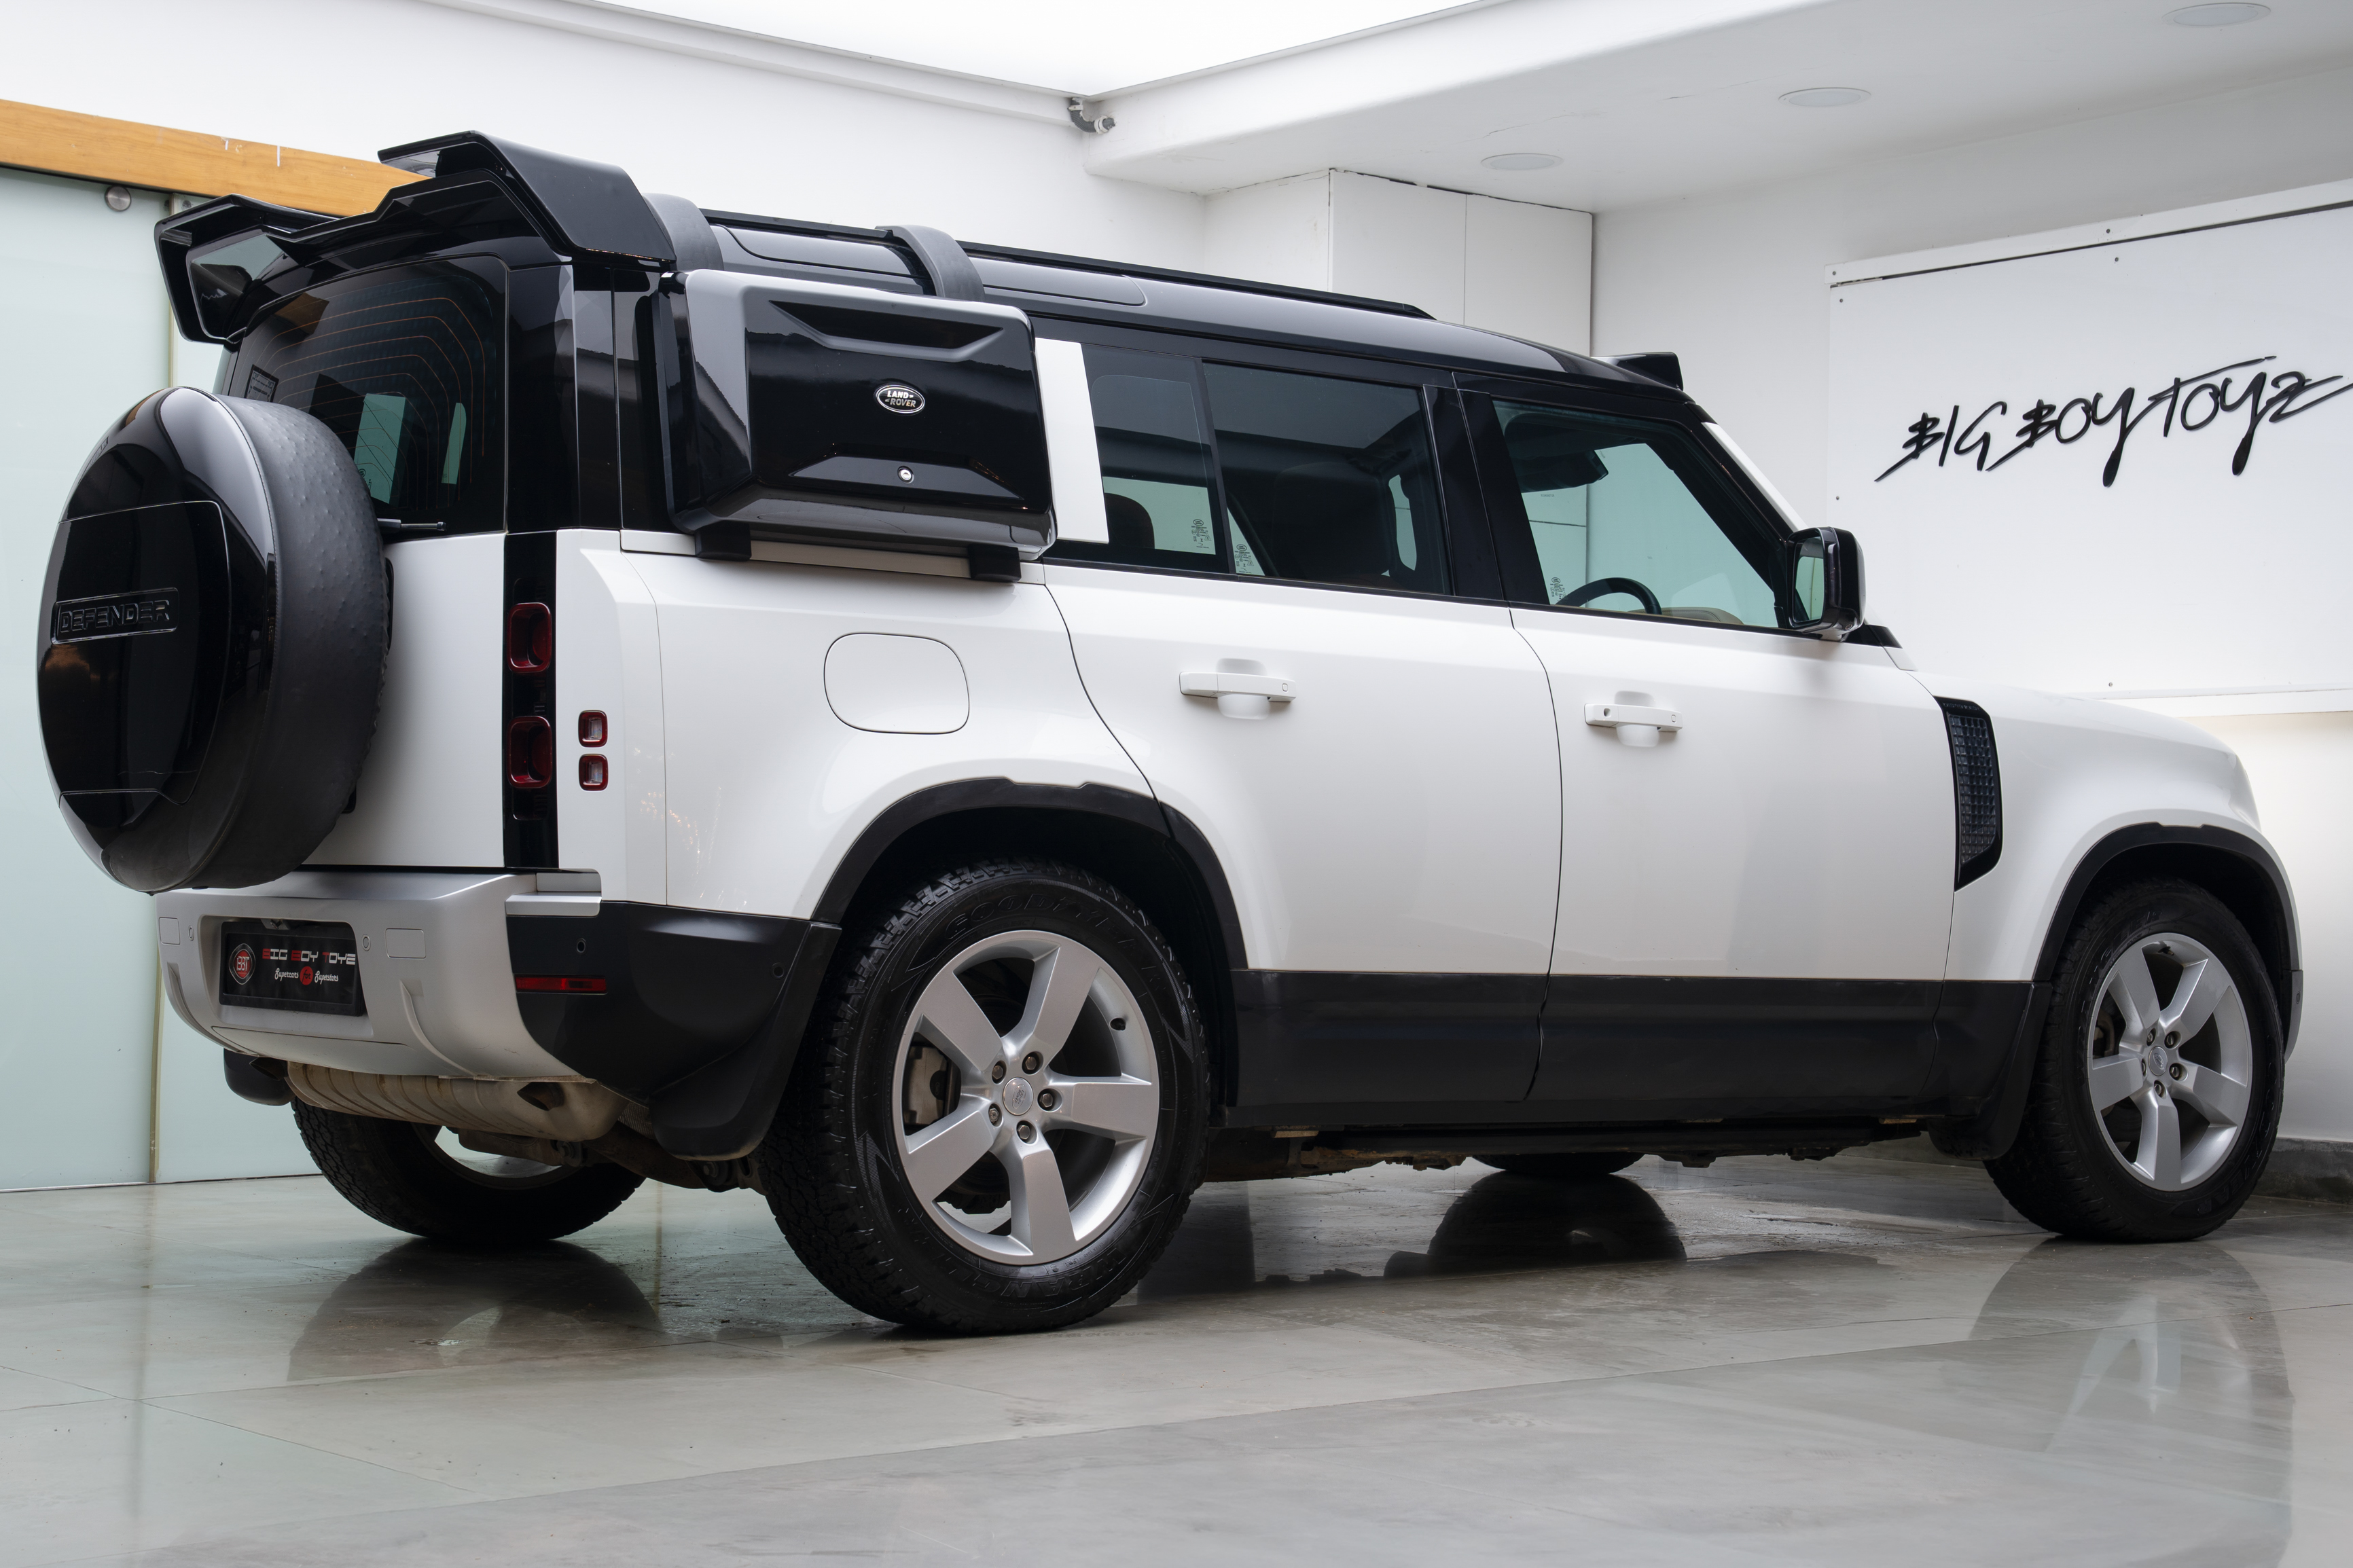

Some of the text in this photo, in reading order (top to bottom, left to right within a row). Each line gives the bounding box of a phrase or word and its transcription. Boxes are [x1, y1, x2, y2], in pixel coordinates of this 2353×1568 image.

[887, 390, 909, 399] LAND
[890, 398, 916, 407] ROVER
[1874, 401, 2007, 482] BIG
[60, 600, 170, 633] DEFENDER
[262, 948, 287, 960] BIG
[291, 950, 318, 962] BOY
[237, 956, 249, 971] BBT
[274, 968, 338, 985] Supercars for Superstars
